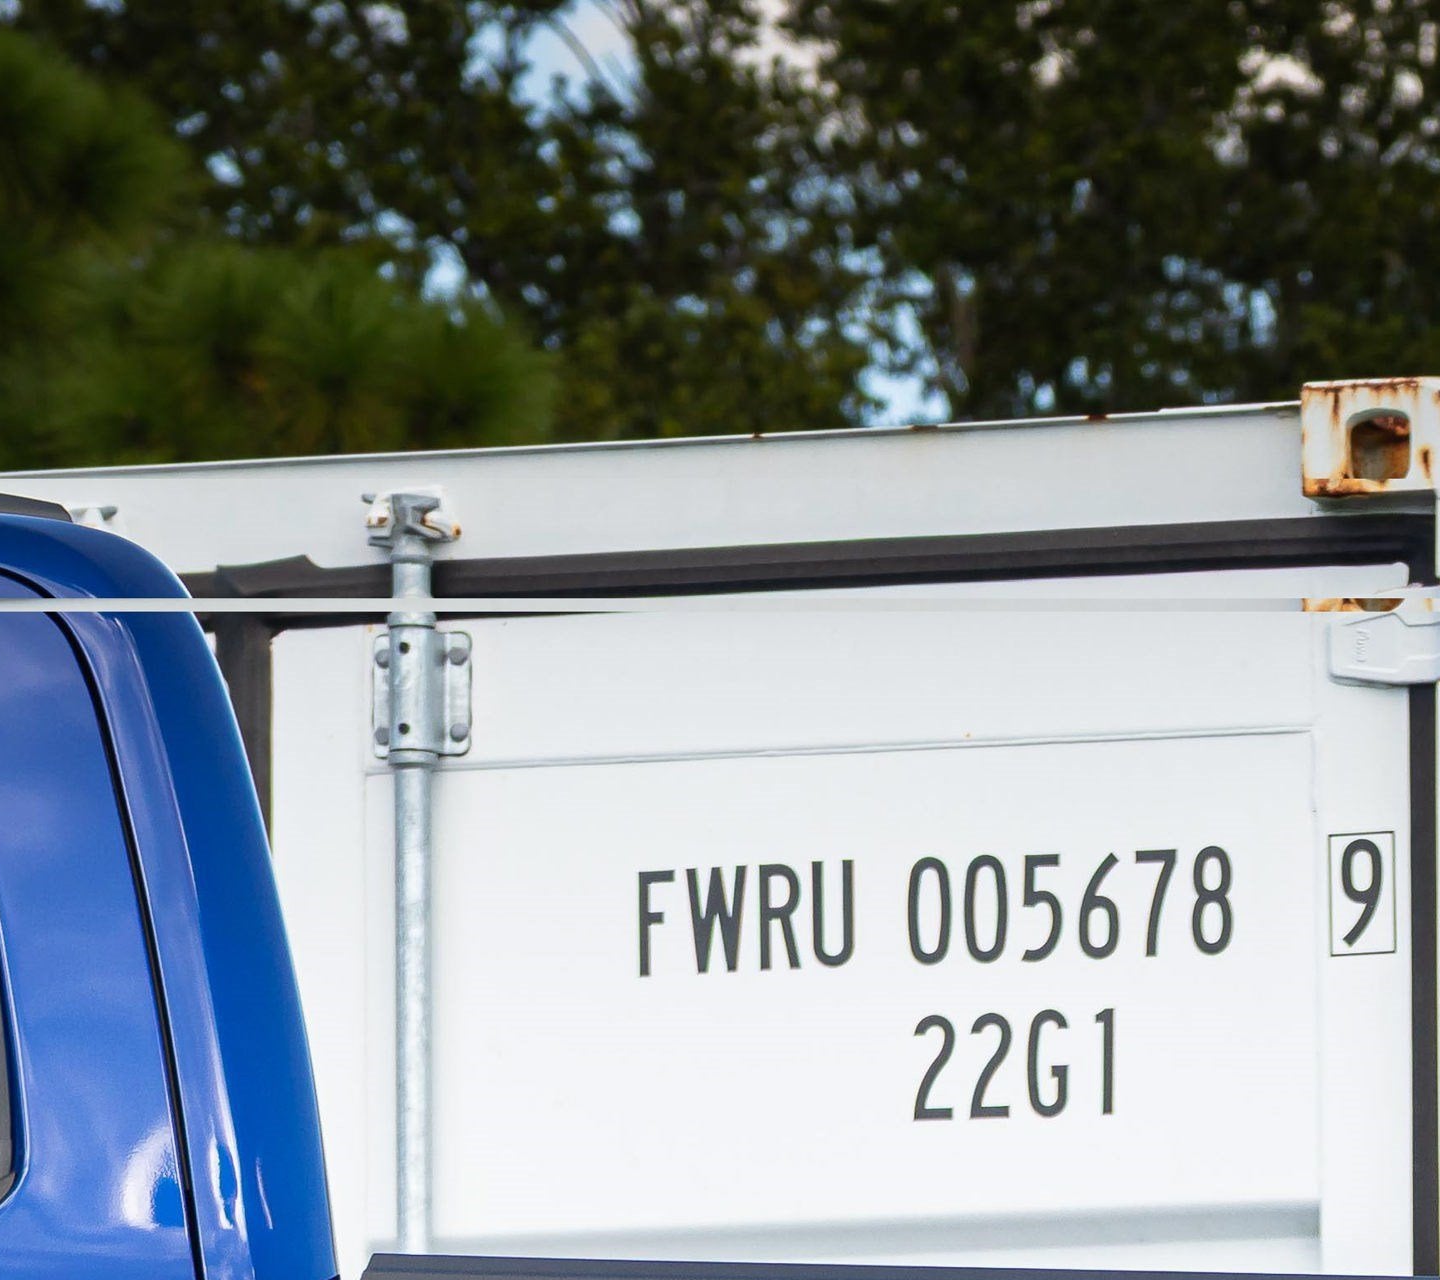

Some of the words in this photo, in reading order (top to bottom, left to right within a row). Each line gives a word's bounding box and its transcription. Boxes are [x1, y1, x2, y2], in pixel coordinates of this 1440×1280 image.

[638, 859, 854, 978] FWRU
[907, 845, 1233, 966] 005678
[1341, 838, 1383, 947] 9
[913, 1007, 1115, 1121] 22G1
